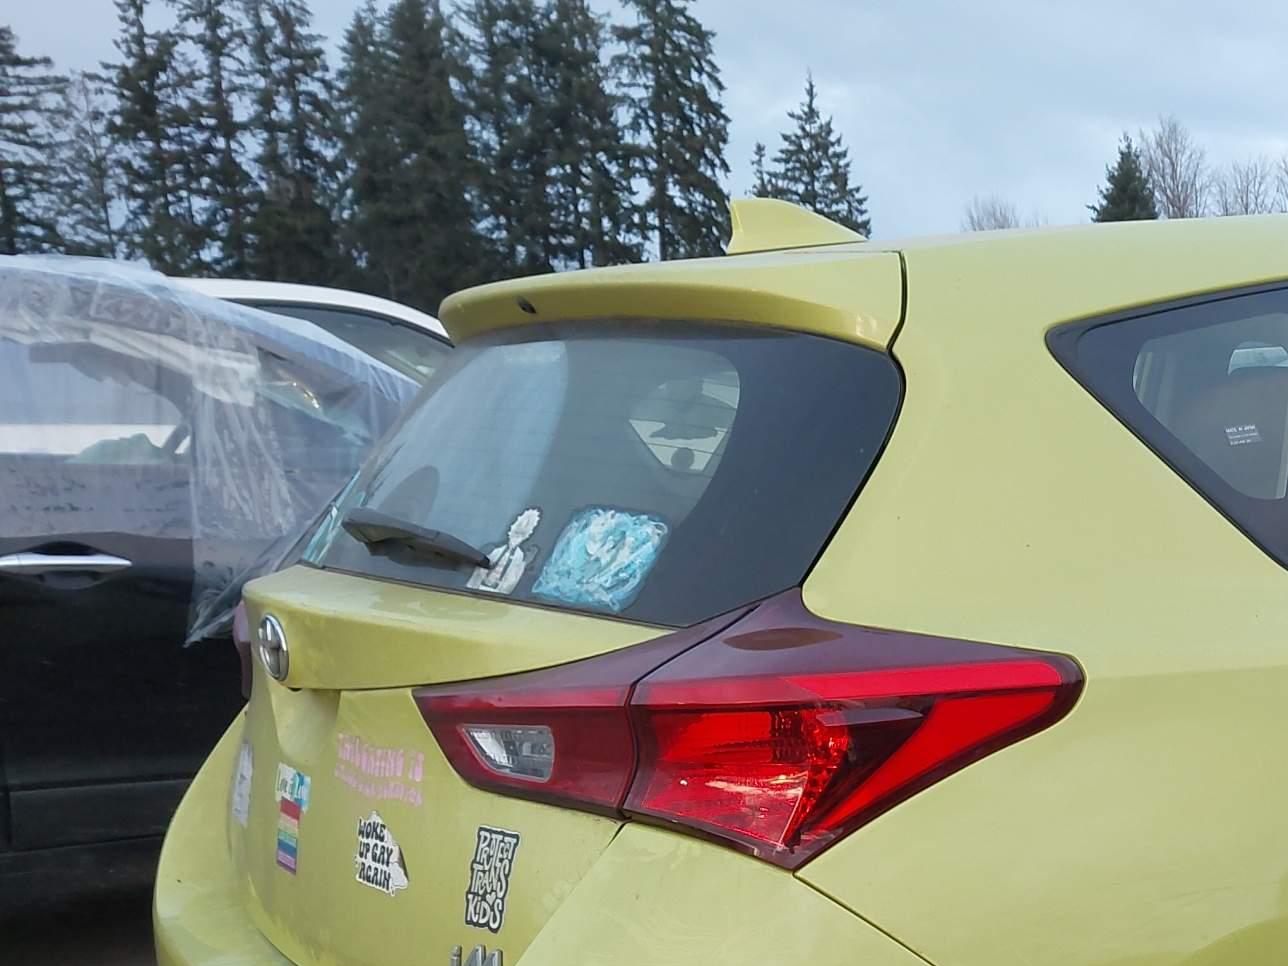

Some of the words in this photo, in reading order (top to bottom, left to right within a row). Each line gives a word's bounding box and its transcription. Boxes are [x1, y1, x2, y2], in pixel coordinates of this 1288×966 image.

[358, 819, 386, 843] WOKE
[359, 841, 371, 860] UP
[371, 843, 394, 868] GAY
[475, 830, 518, 871] PROTECT
[358, 862, 391, 891] AGAIN
[470, 860, 509, 898] TRANS
